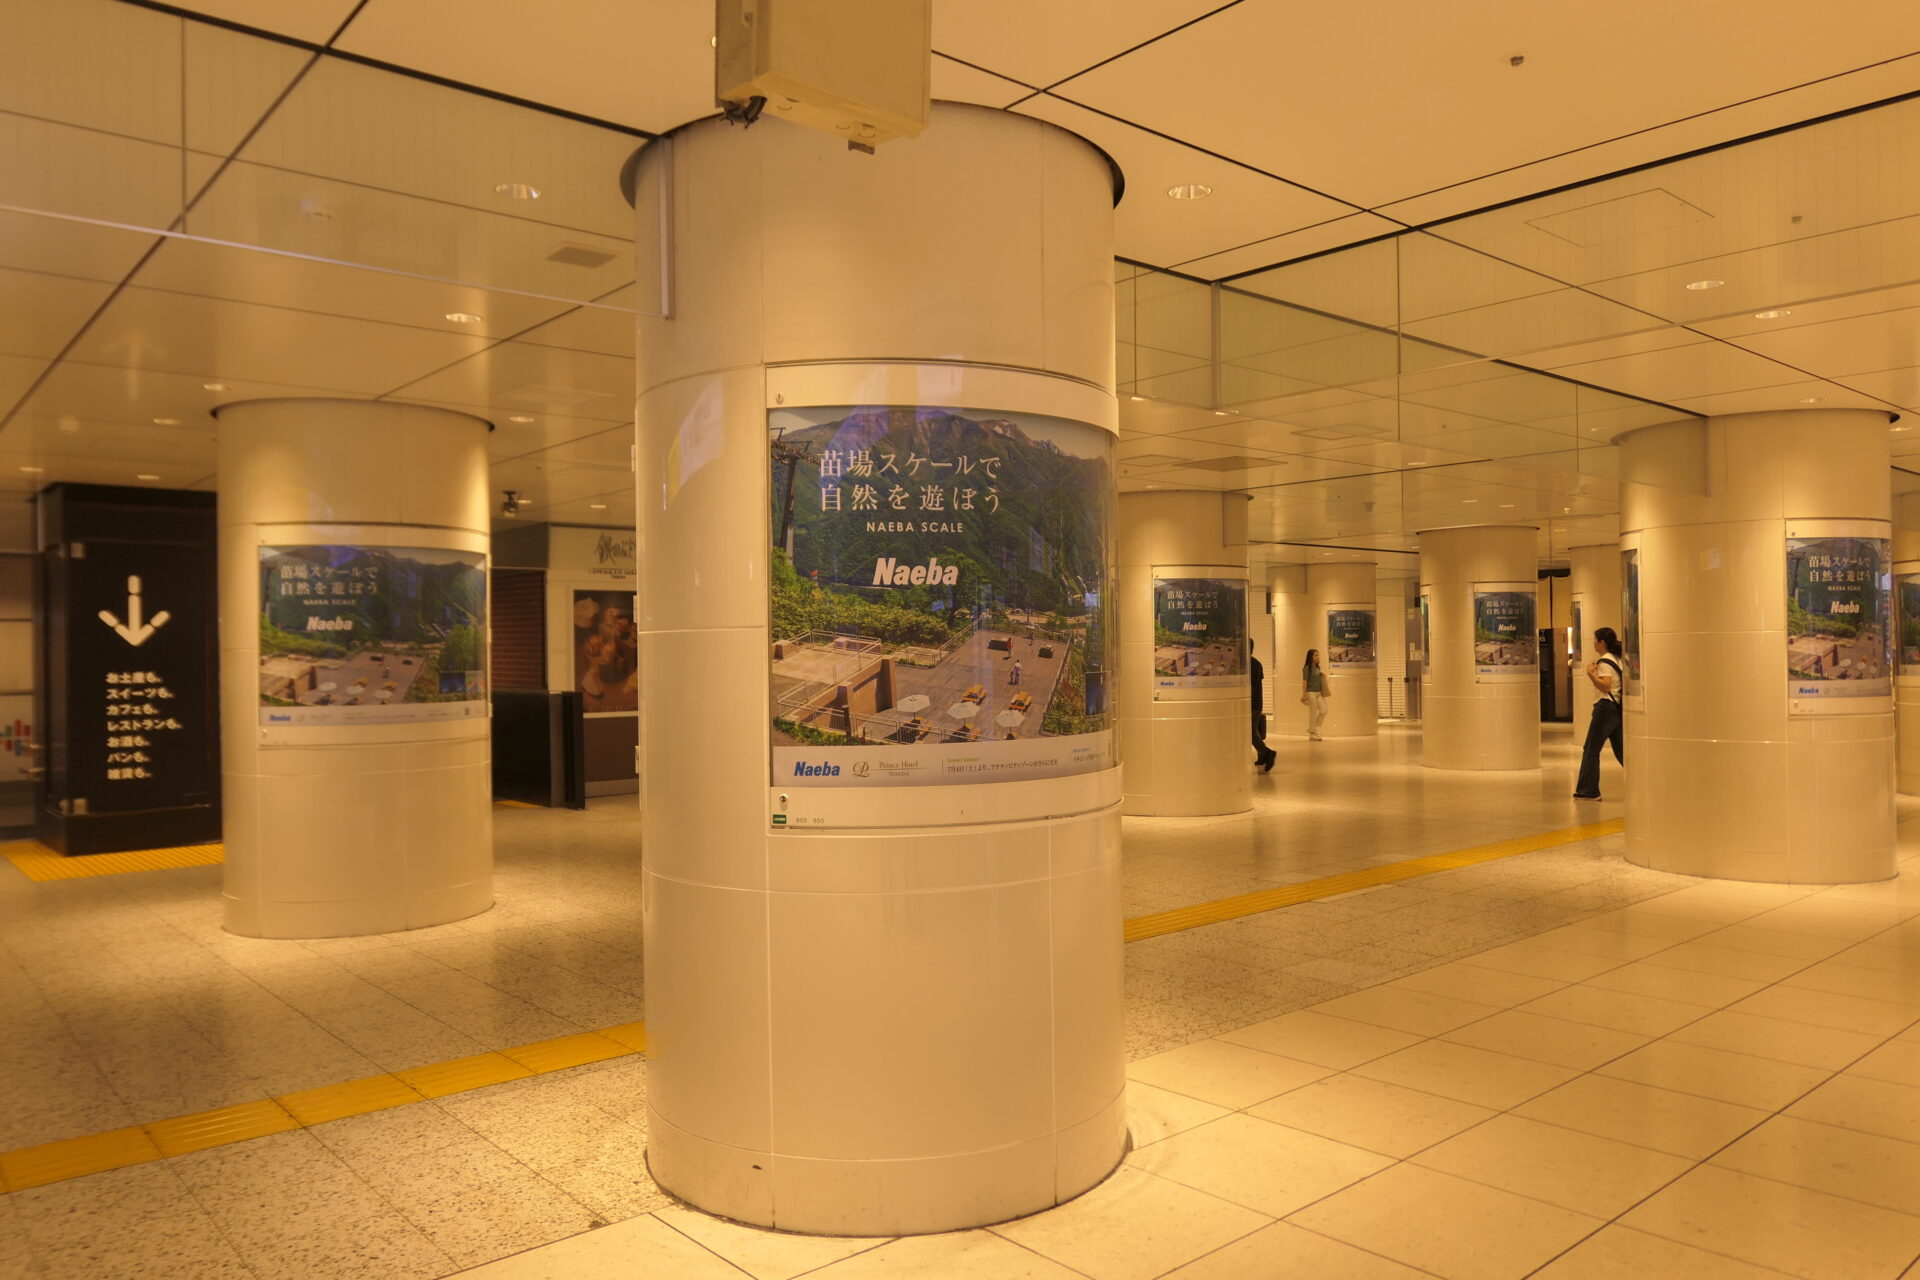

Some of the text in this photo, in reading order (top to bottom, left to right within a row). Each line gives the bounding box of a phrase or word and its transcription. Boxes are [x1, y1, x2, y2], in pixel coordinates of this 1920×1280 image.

[818, 449, 1001, 479] 苗場スケールで
[820, 483, 1001, 514] 自然を遊ぼう
[866, 521, 964, 533] NAEBA SCALE
[872, 557, 959, 586] Naeba
[1830, 601, 1860, 614] Naeba
[306, 616, 353, 631] Naeba
[1183, 621, 1207, 631] Naeba
[106, 687, 175, 699] スイーツも。
[106, 703, 159, 715] カフェも。
[107, 718, 182, 731] レストランも。
[793, 761, 841, 777] Naeba
[879, 760, 919, 769] Prince Hotel
